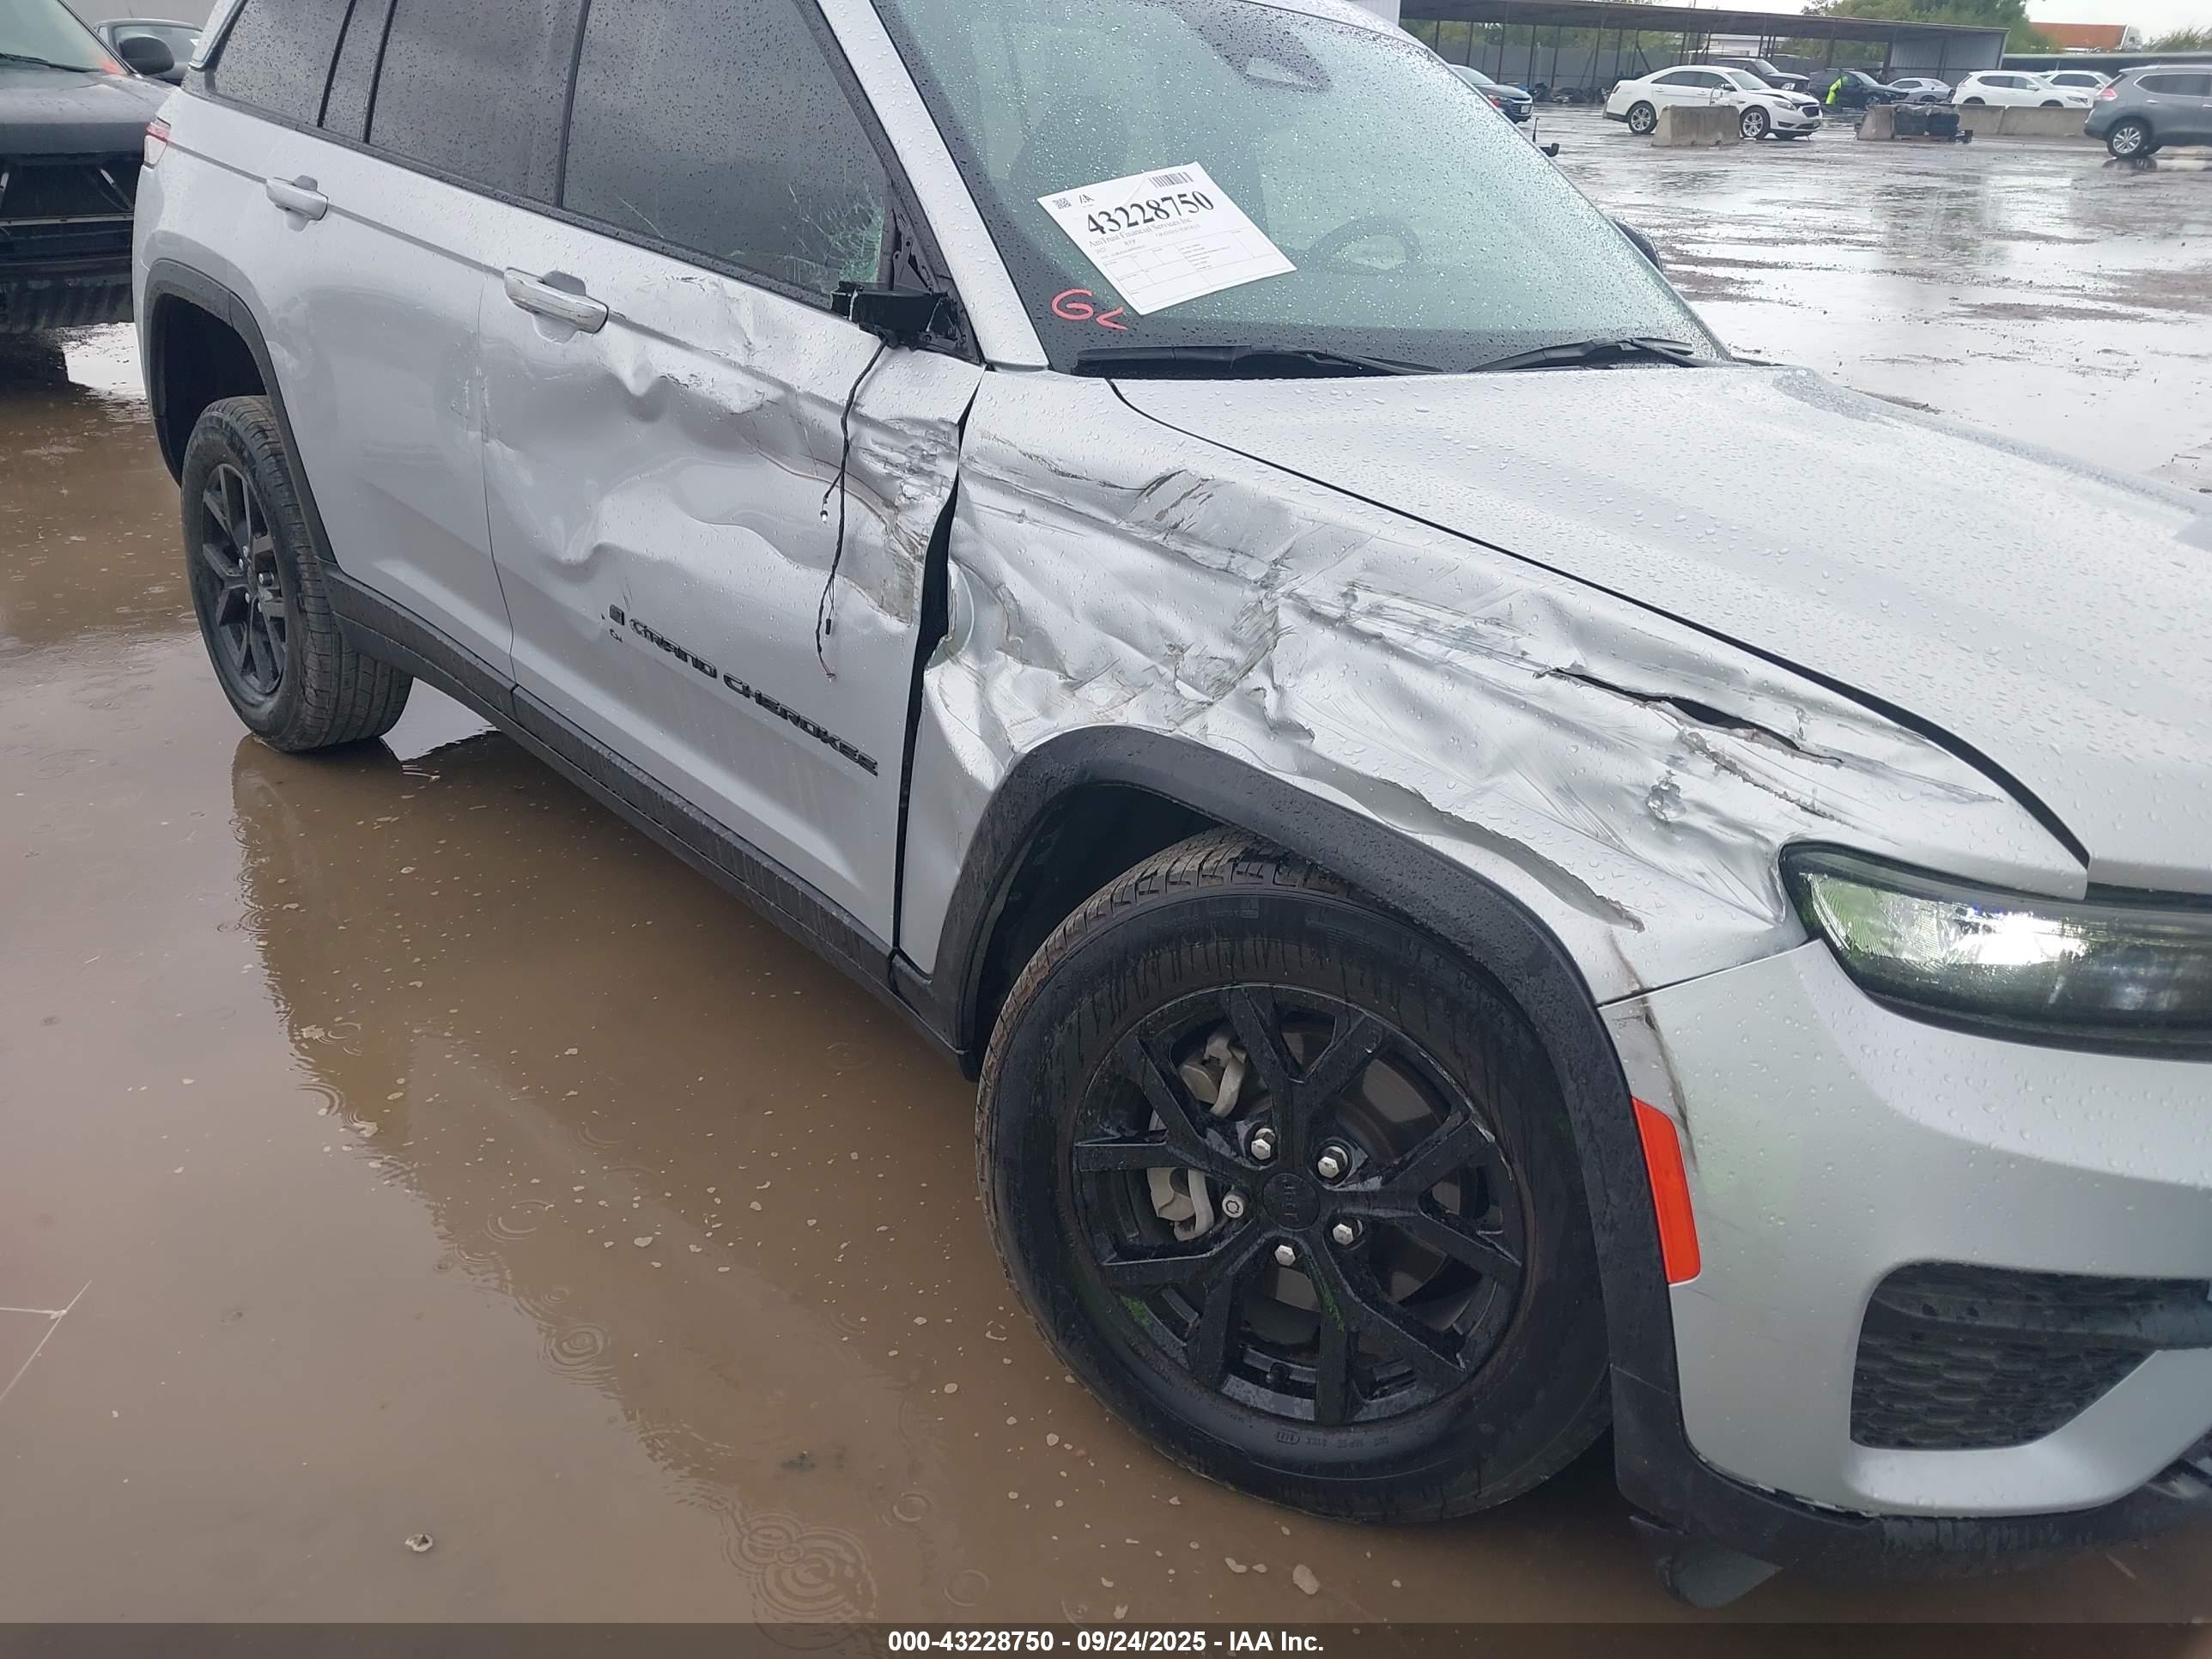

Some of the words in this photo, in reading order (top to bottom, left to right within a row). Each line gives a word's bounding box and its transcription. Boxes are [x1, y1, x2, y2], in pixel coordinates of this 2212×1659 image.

[1088, 191, 1214, 234] 43228750
[629, 618, 717, 678] GRAND
[723, 672, 878, 776] CHEROKEE
